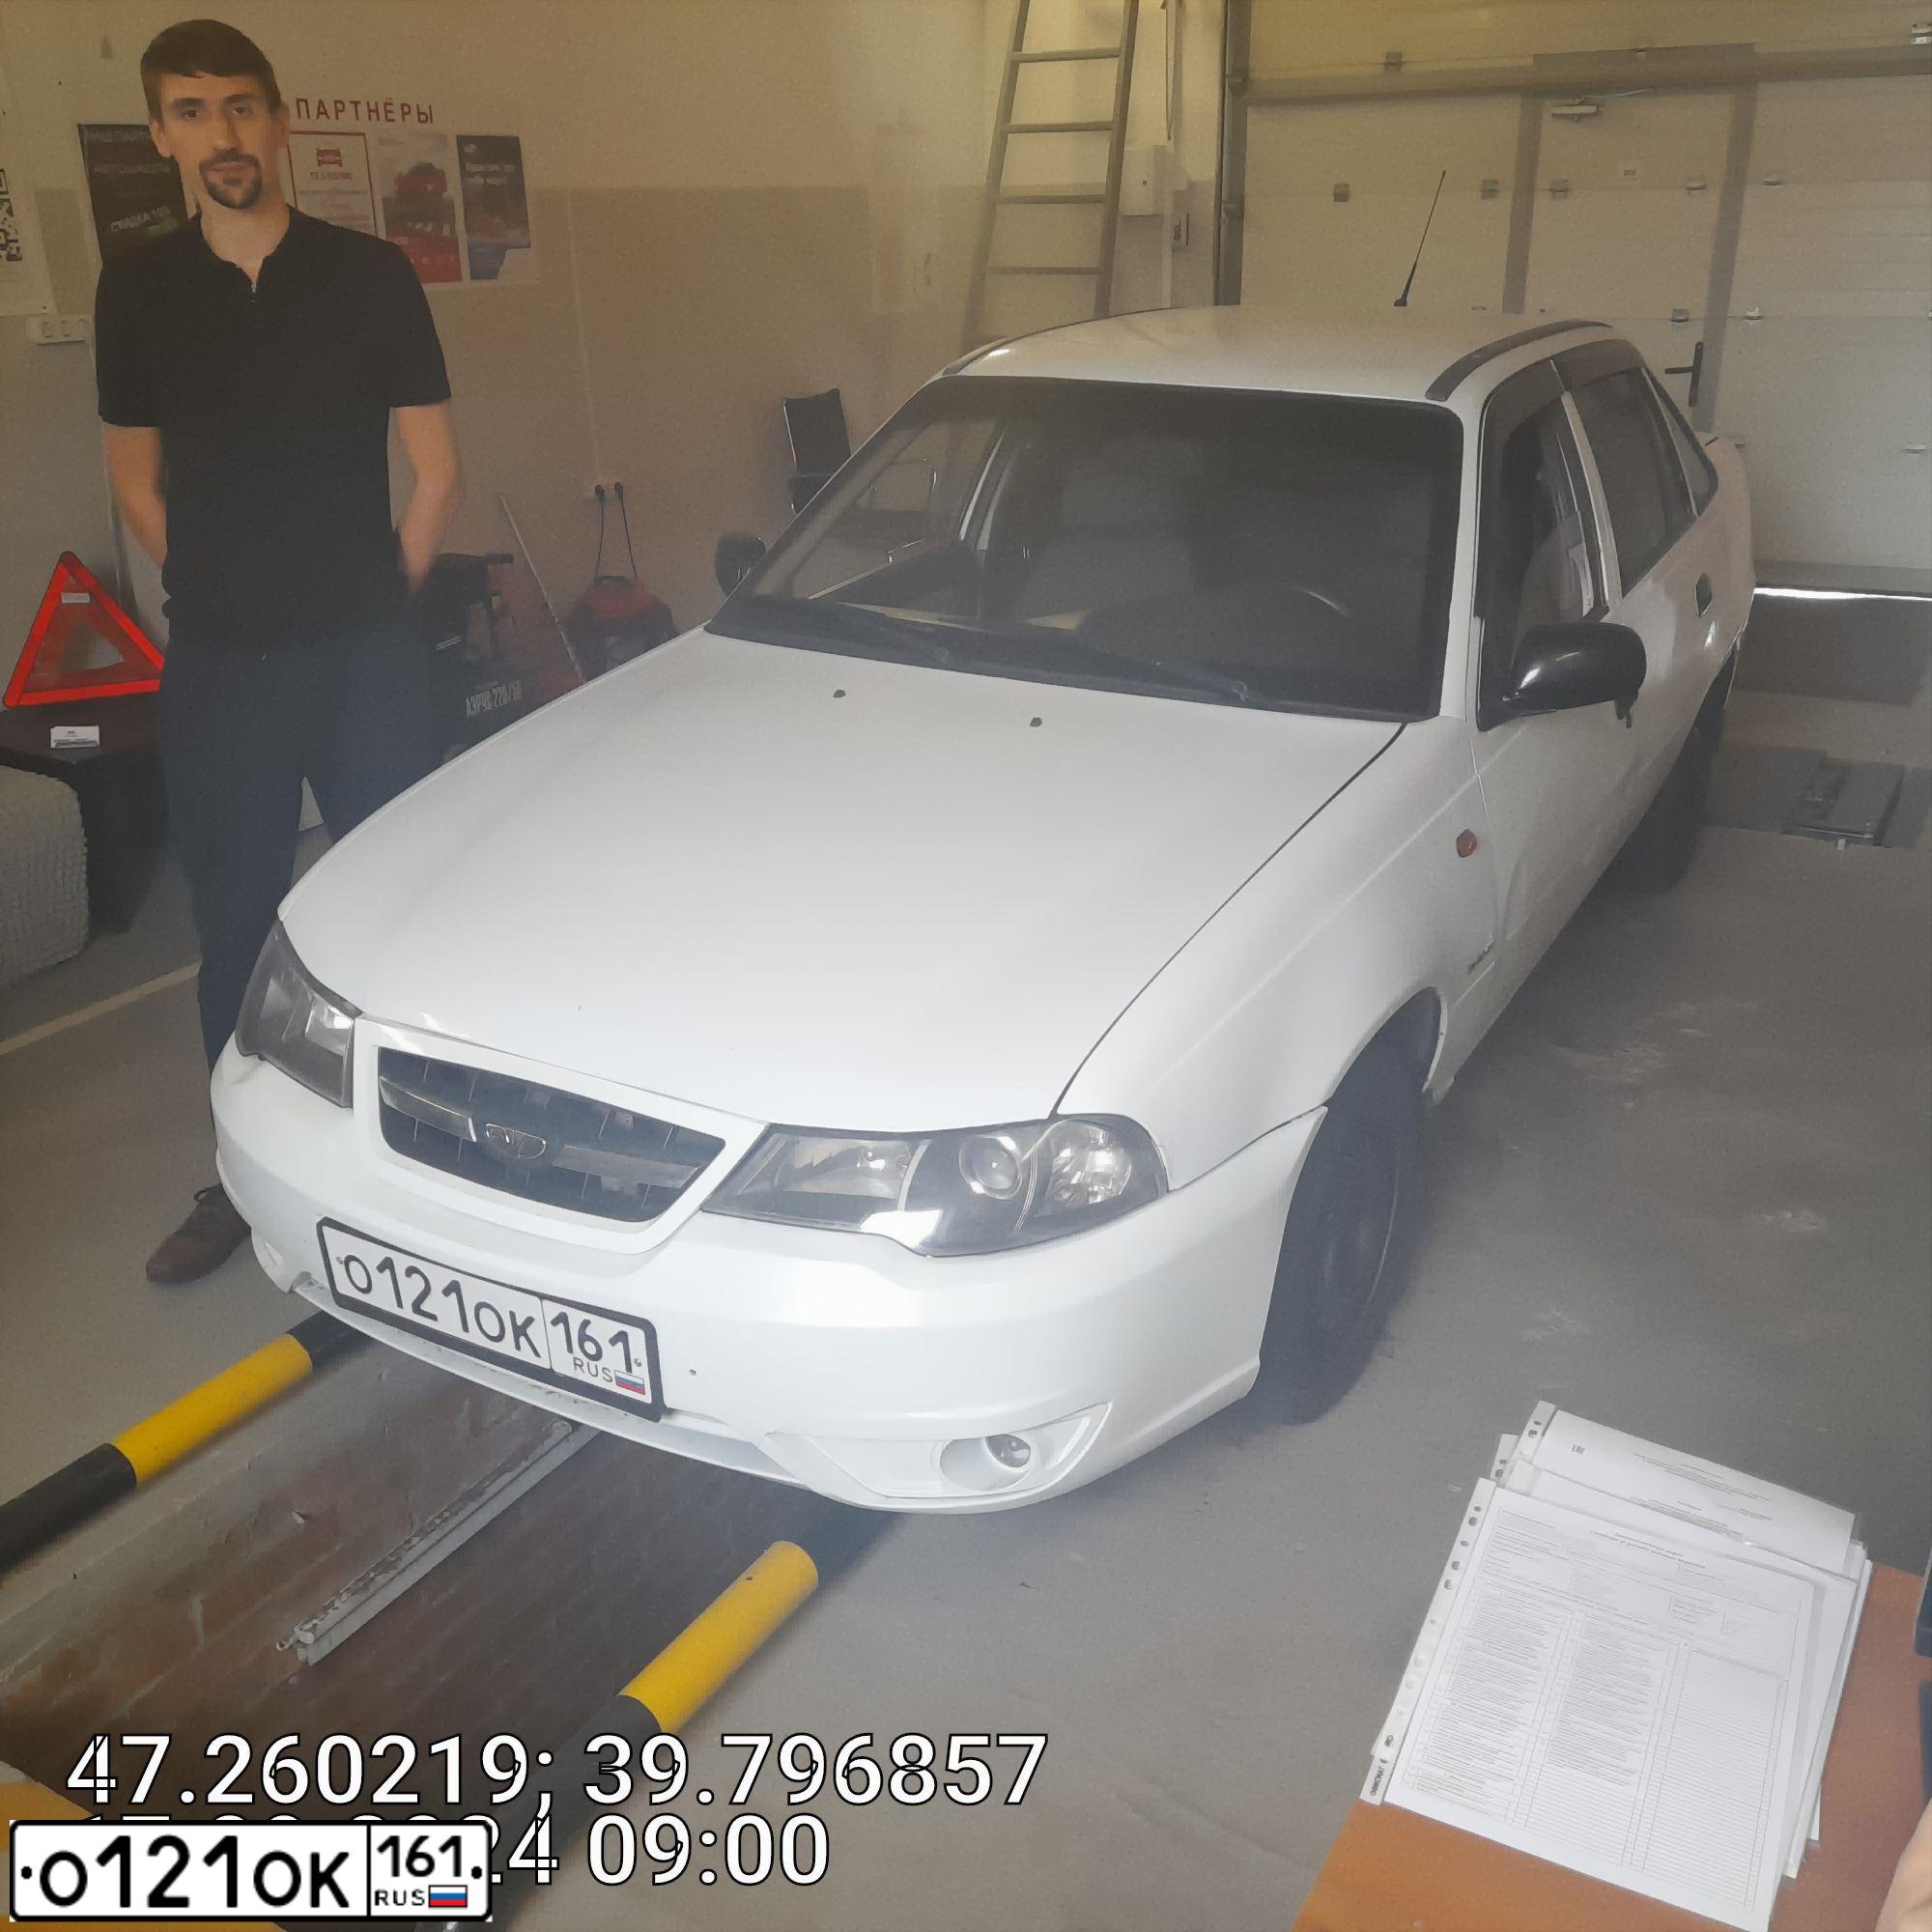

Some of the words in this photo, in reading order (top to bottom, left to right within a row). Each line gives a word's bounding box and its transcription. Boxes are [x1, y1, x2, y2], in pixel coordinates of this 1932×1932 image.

[296, 97, 434, 124] ПАРТНЁРЫ
[550, 1311, 634, 1374] 161
[572, 1356, 614, 1383] RUS
